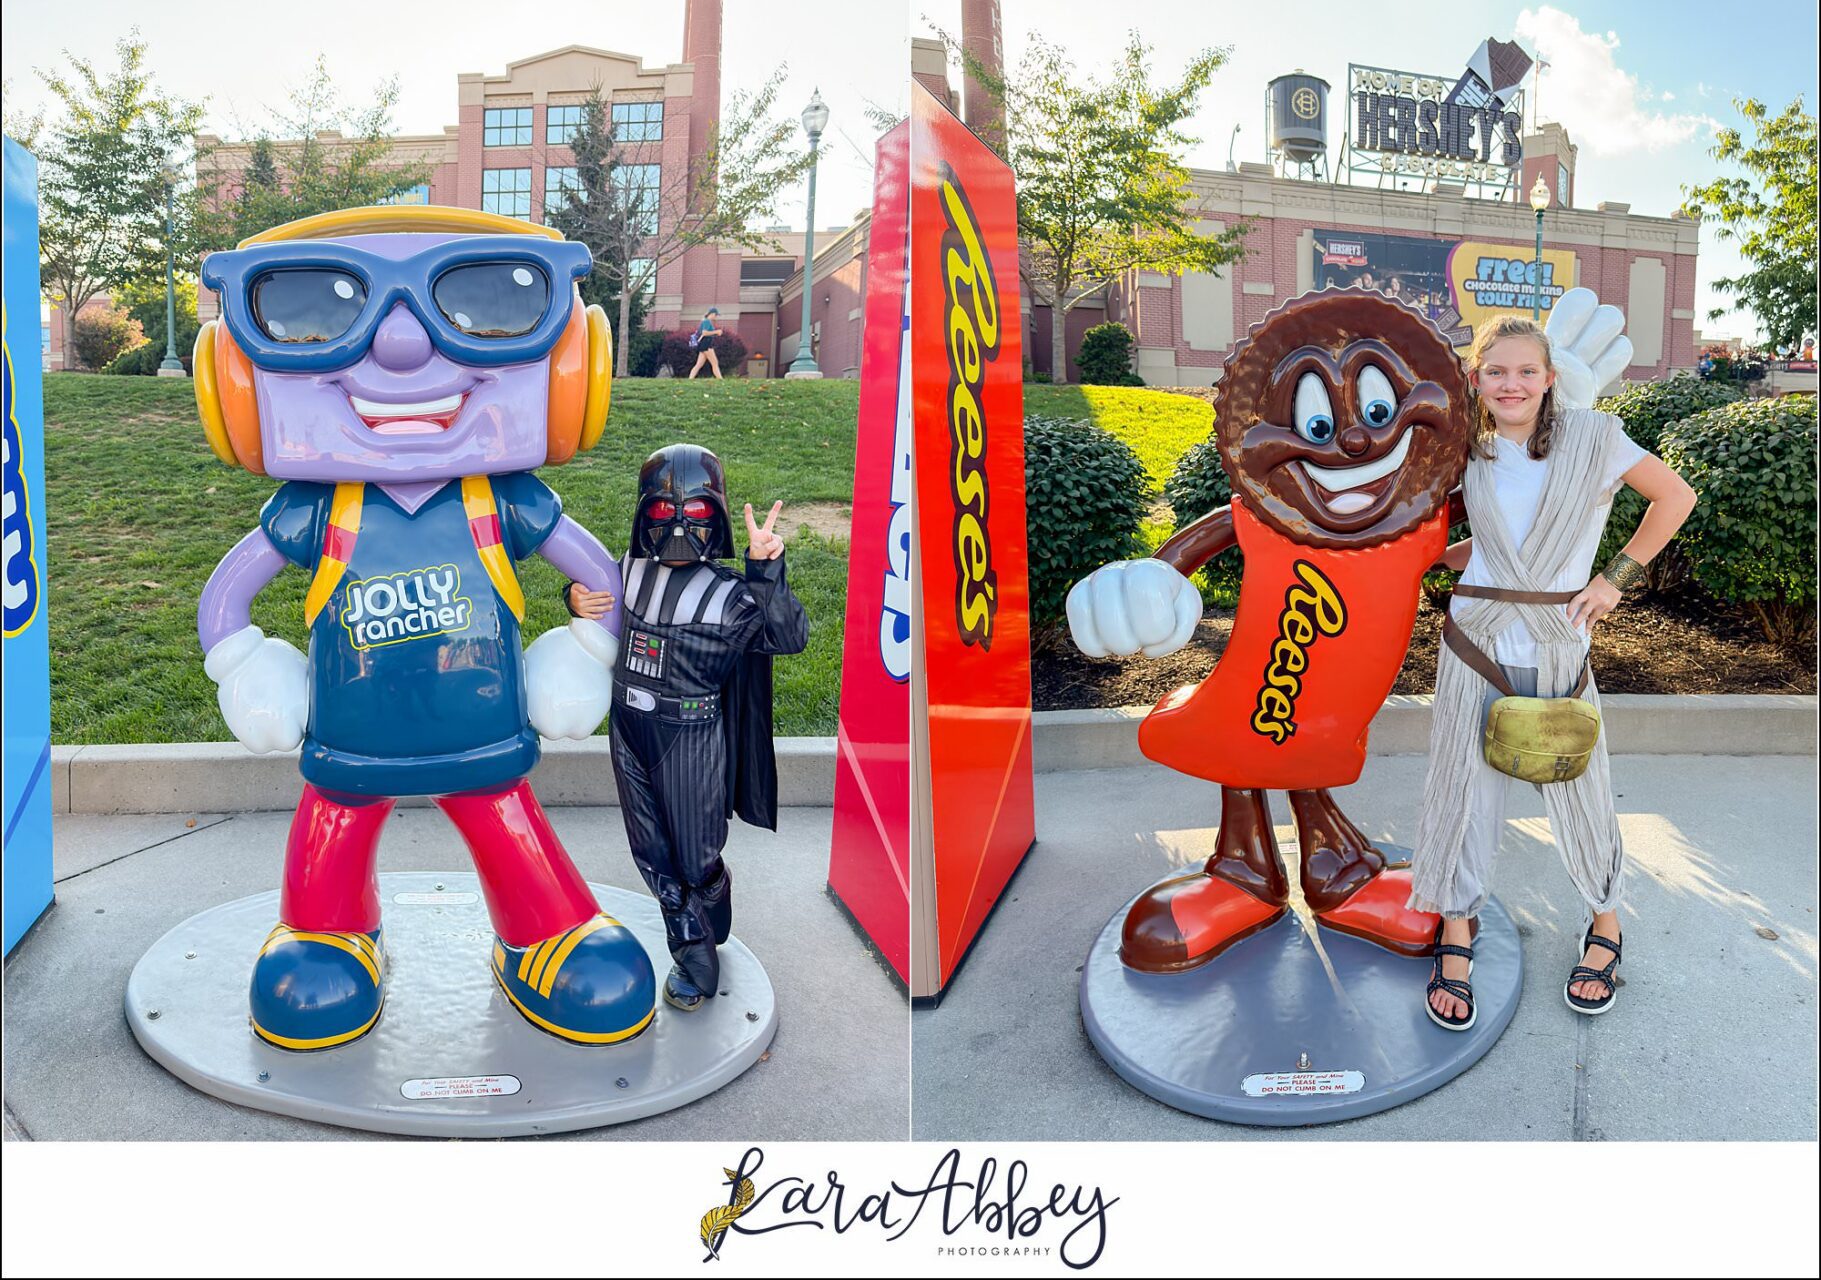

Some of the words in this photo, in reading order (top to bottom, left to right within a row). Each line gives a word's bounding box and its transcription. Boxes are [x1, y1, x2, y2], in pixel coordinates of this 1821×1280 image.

[1356, 71, 1414, 94] HOME
[1418, 80, 1444, 98] OF
[1357, 92, 1521, 167] HERSHEY'S
[1381, 153, 1499, 180] CHOCOLATE
[1330, 243, 1361, 256] HERSHEY'S
[943, 179, 997, 637] Reese's
[348, 571, 453, 622] JOLLY
[356, 604, 465, 643] rancher
[1255, 564, 1344, 742] Reese's
